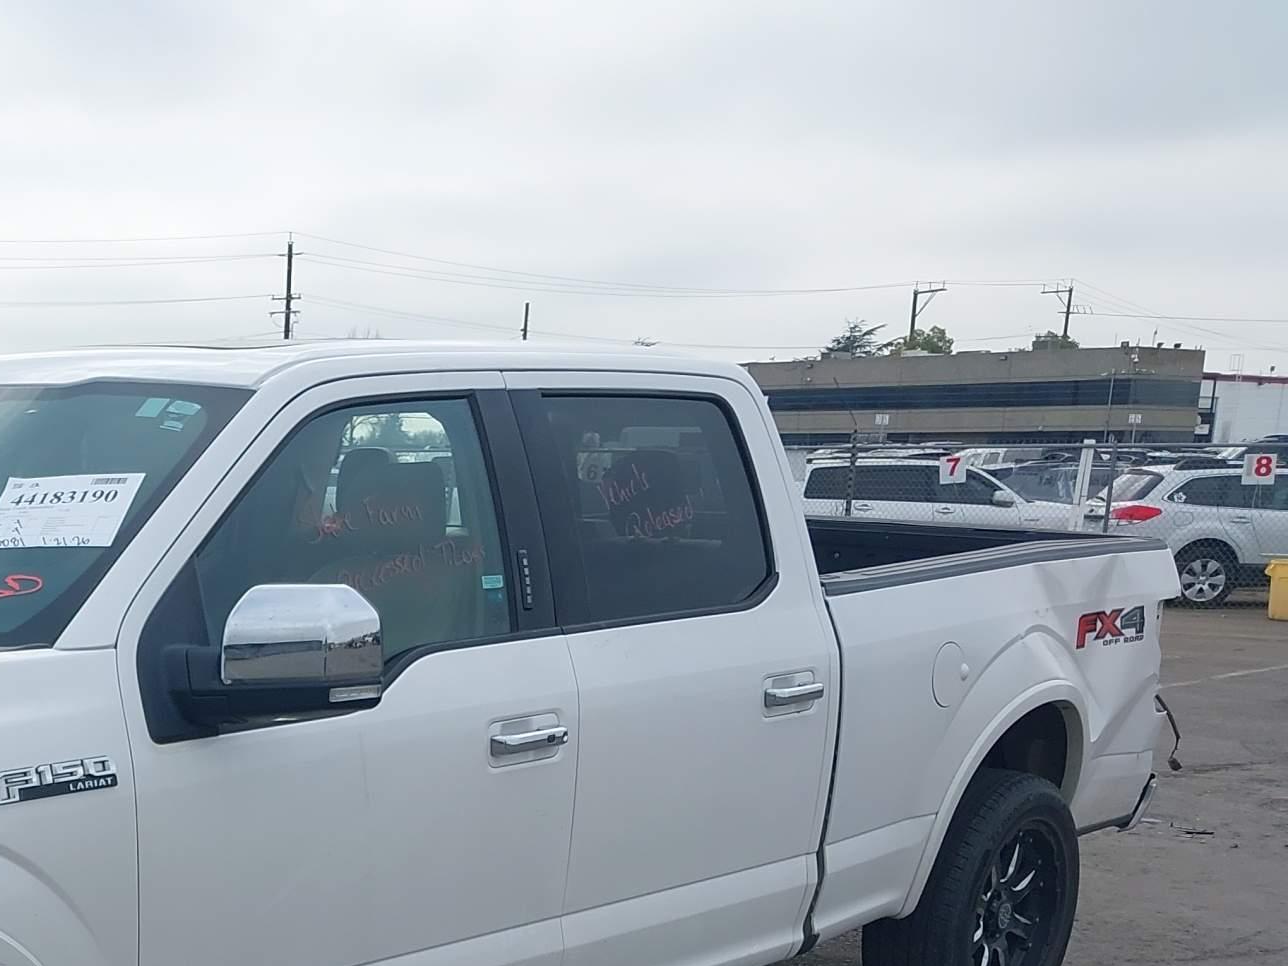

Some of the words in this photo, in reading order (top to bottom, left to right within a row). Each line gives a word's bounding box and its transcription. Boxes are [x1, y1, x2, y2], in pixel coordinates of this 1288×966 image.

[946, 457, 960, 476] 7
[1254, 456, 1272, 476] 8
[10, 489, 119, 507] 44183190
[1075, 605, 1145, 650] FX4
[1102, 638, 1121, 646] OFF
[1123, 634, 1145, 644] ROAD
[69, 776, 114, 792] LARIAT
